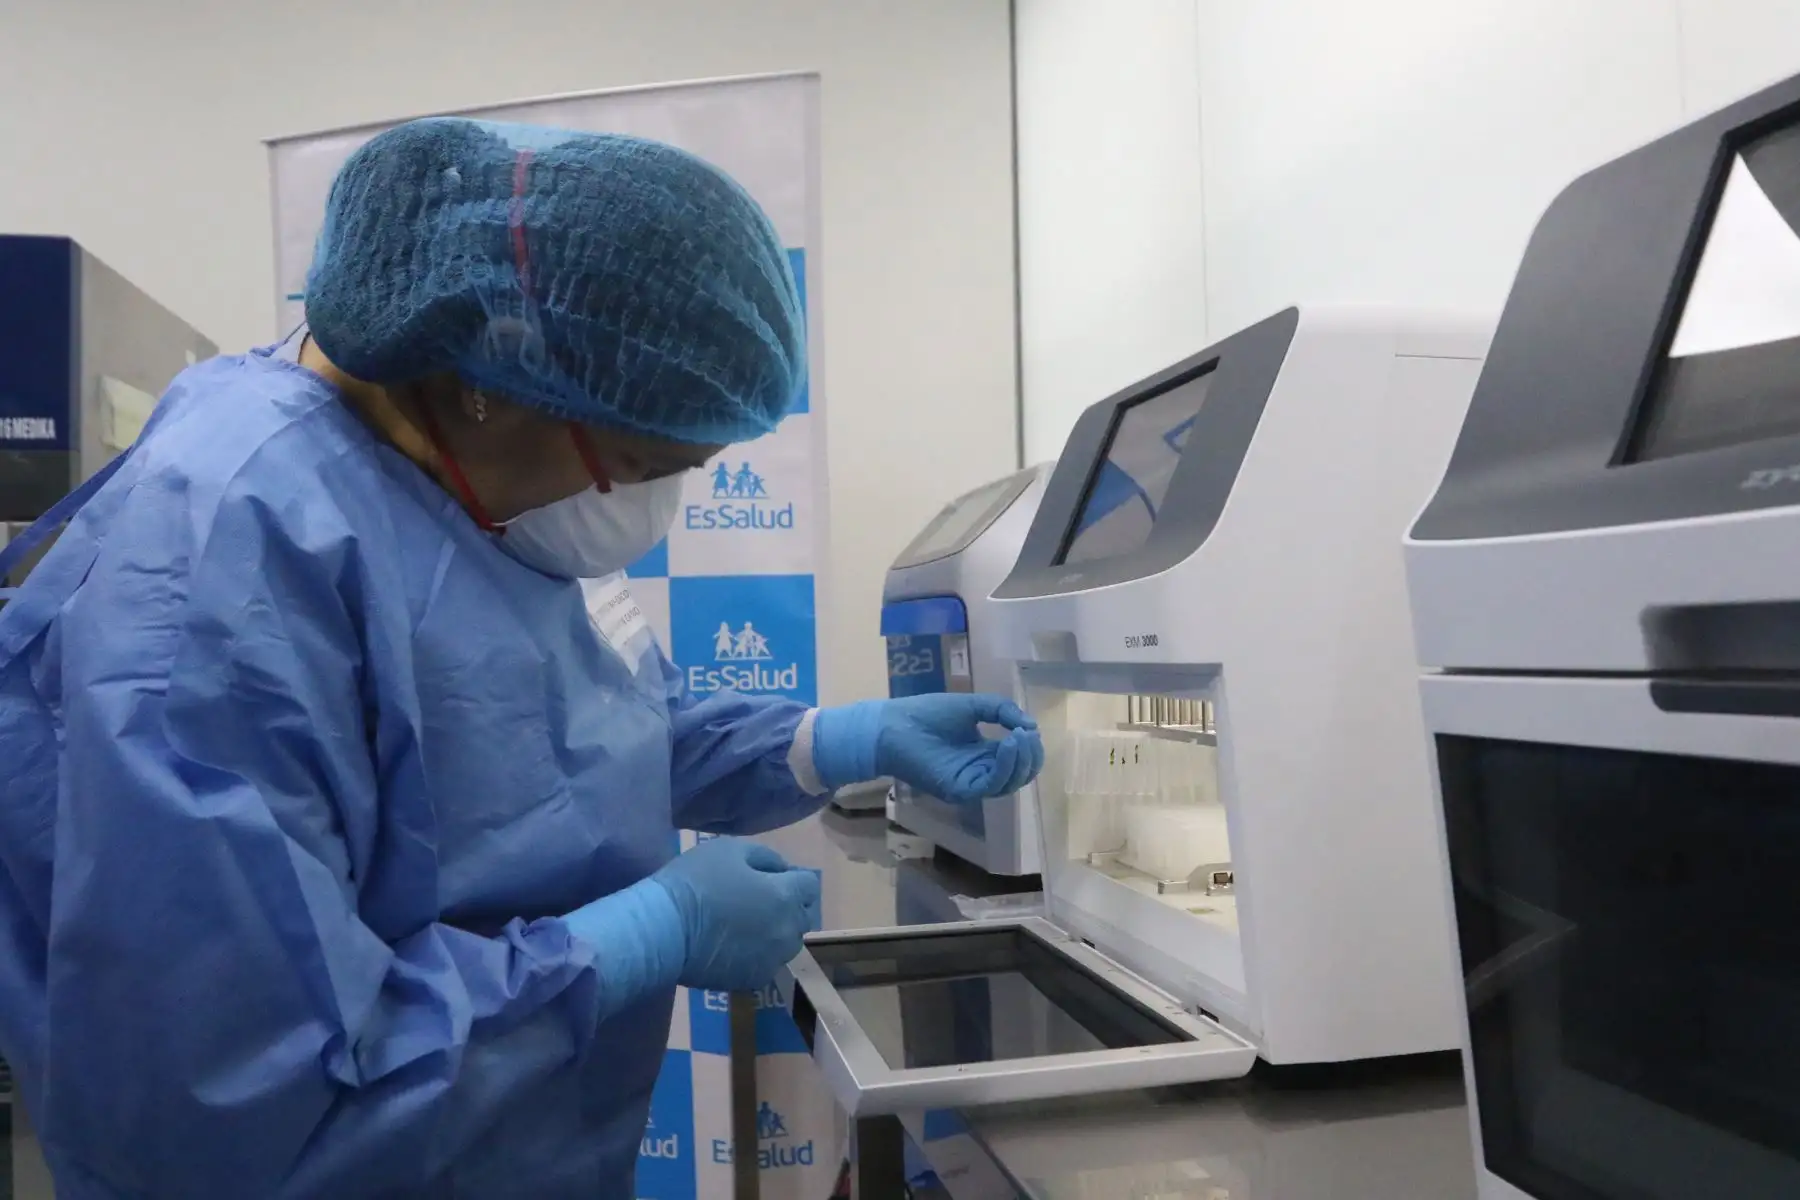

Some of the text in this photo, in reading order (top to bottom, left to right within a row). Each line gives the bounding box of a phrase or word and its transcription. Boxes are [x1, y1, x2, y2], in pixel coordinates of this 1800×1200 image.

[685, 502, 793, 530] EsSalud
[688, 662, 798, 691] EsSalud
[711, 1139, 814, 1170] Esalud
